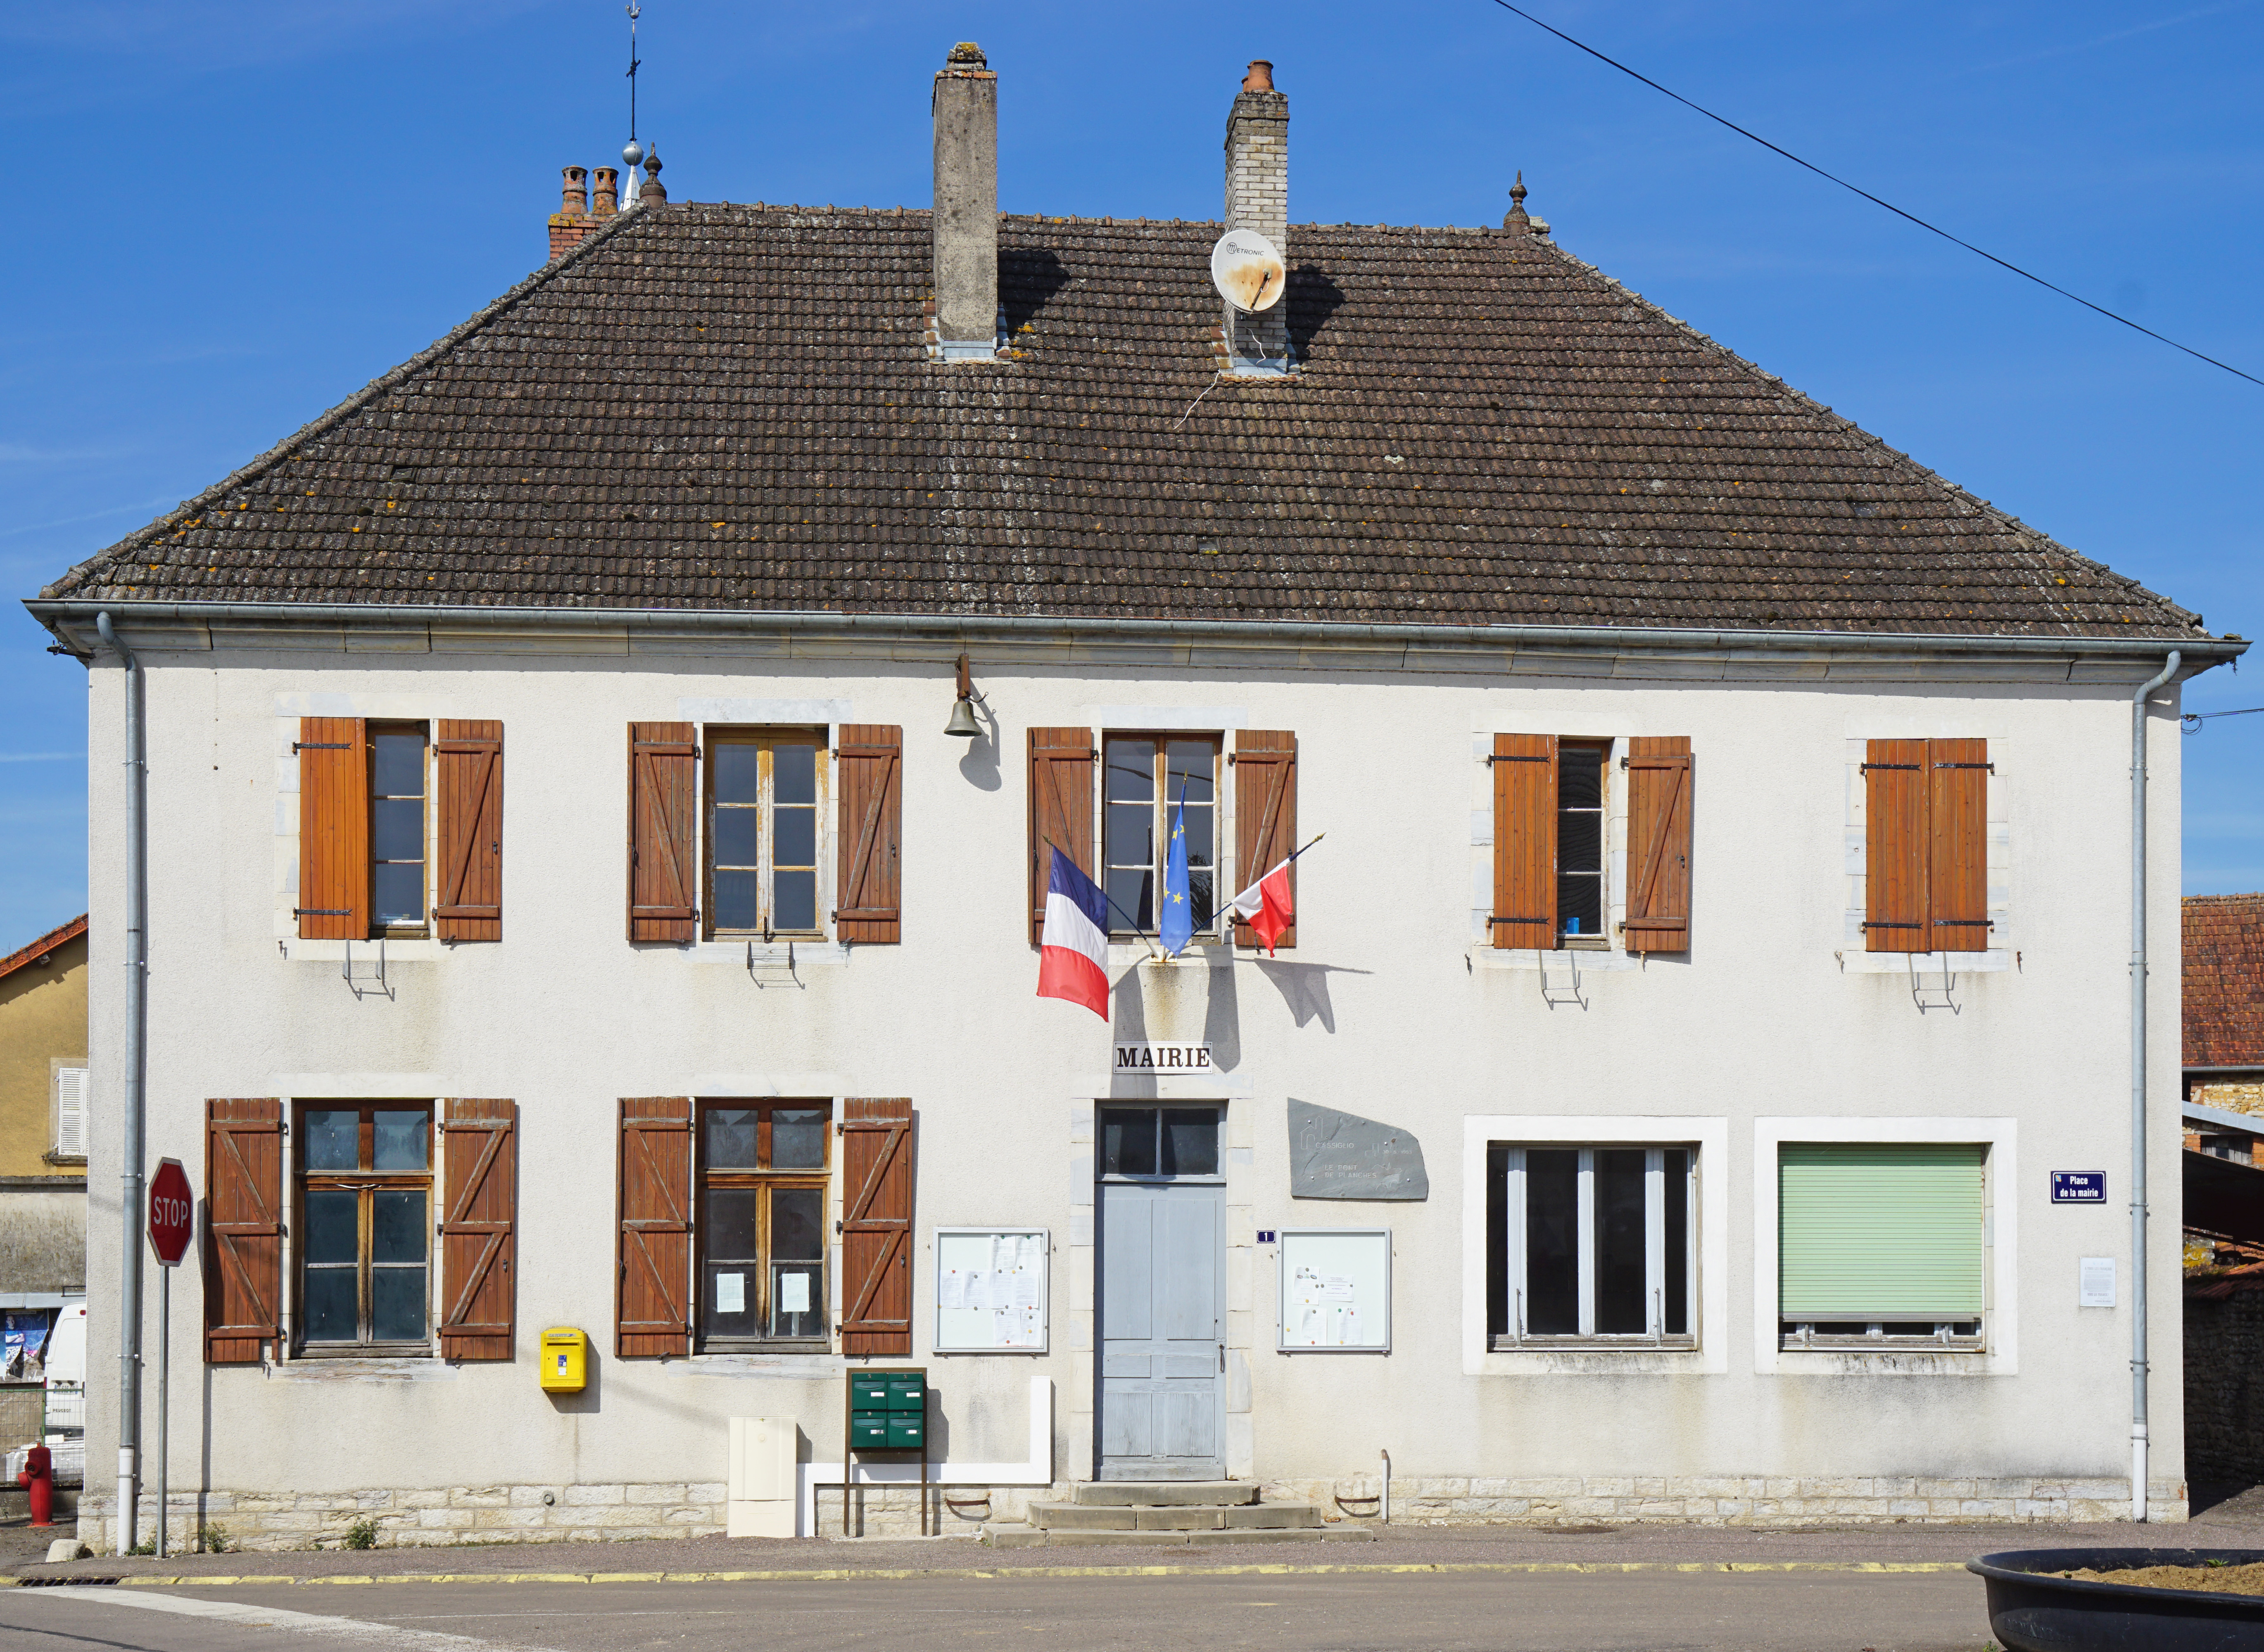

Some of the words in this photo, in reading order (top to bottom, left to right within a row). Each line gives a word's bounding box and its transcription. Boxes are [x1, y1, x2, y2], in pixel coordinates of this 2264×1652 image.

[1117, 1047, 1210, 1067] MAIRIE
[2070, 1175, 2088, 1185] Place
[2060, 1188, 2068, 1197] de
[2070, 1188, 2076, 1197] la
[2078, 1188, 2098, 1197] mairie
[154, 1196, 188, 1228] STOP
[1264, 1232, 1268, 1241] 1
